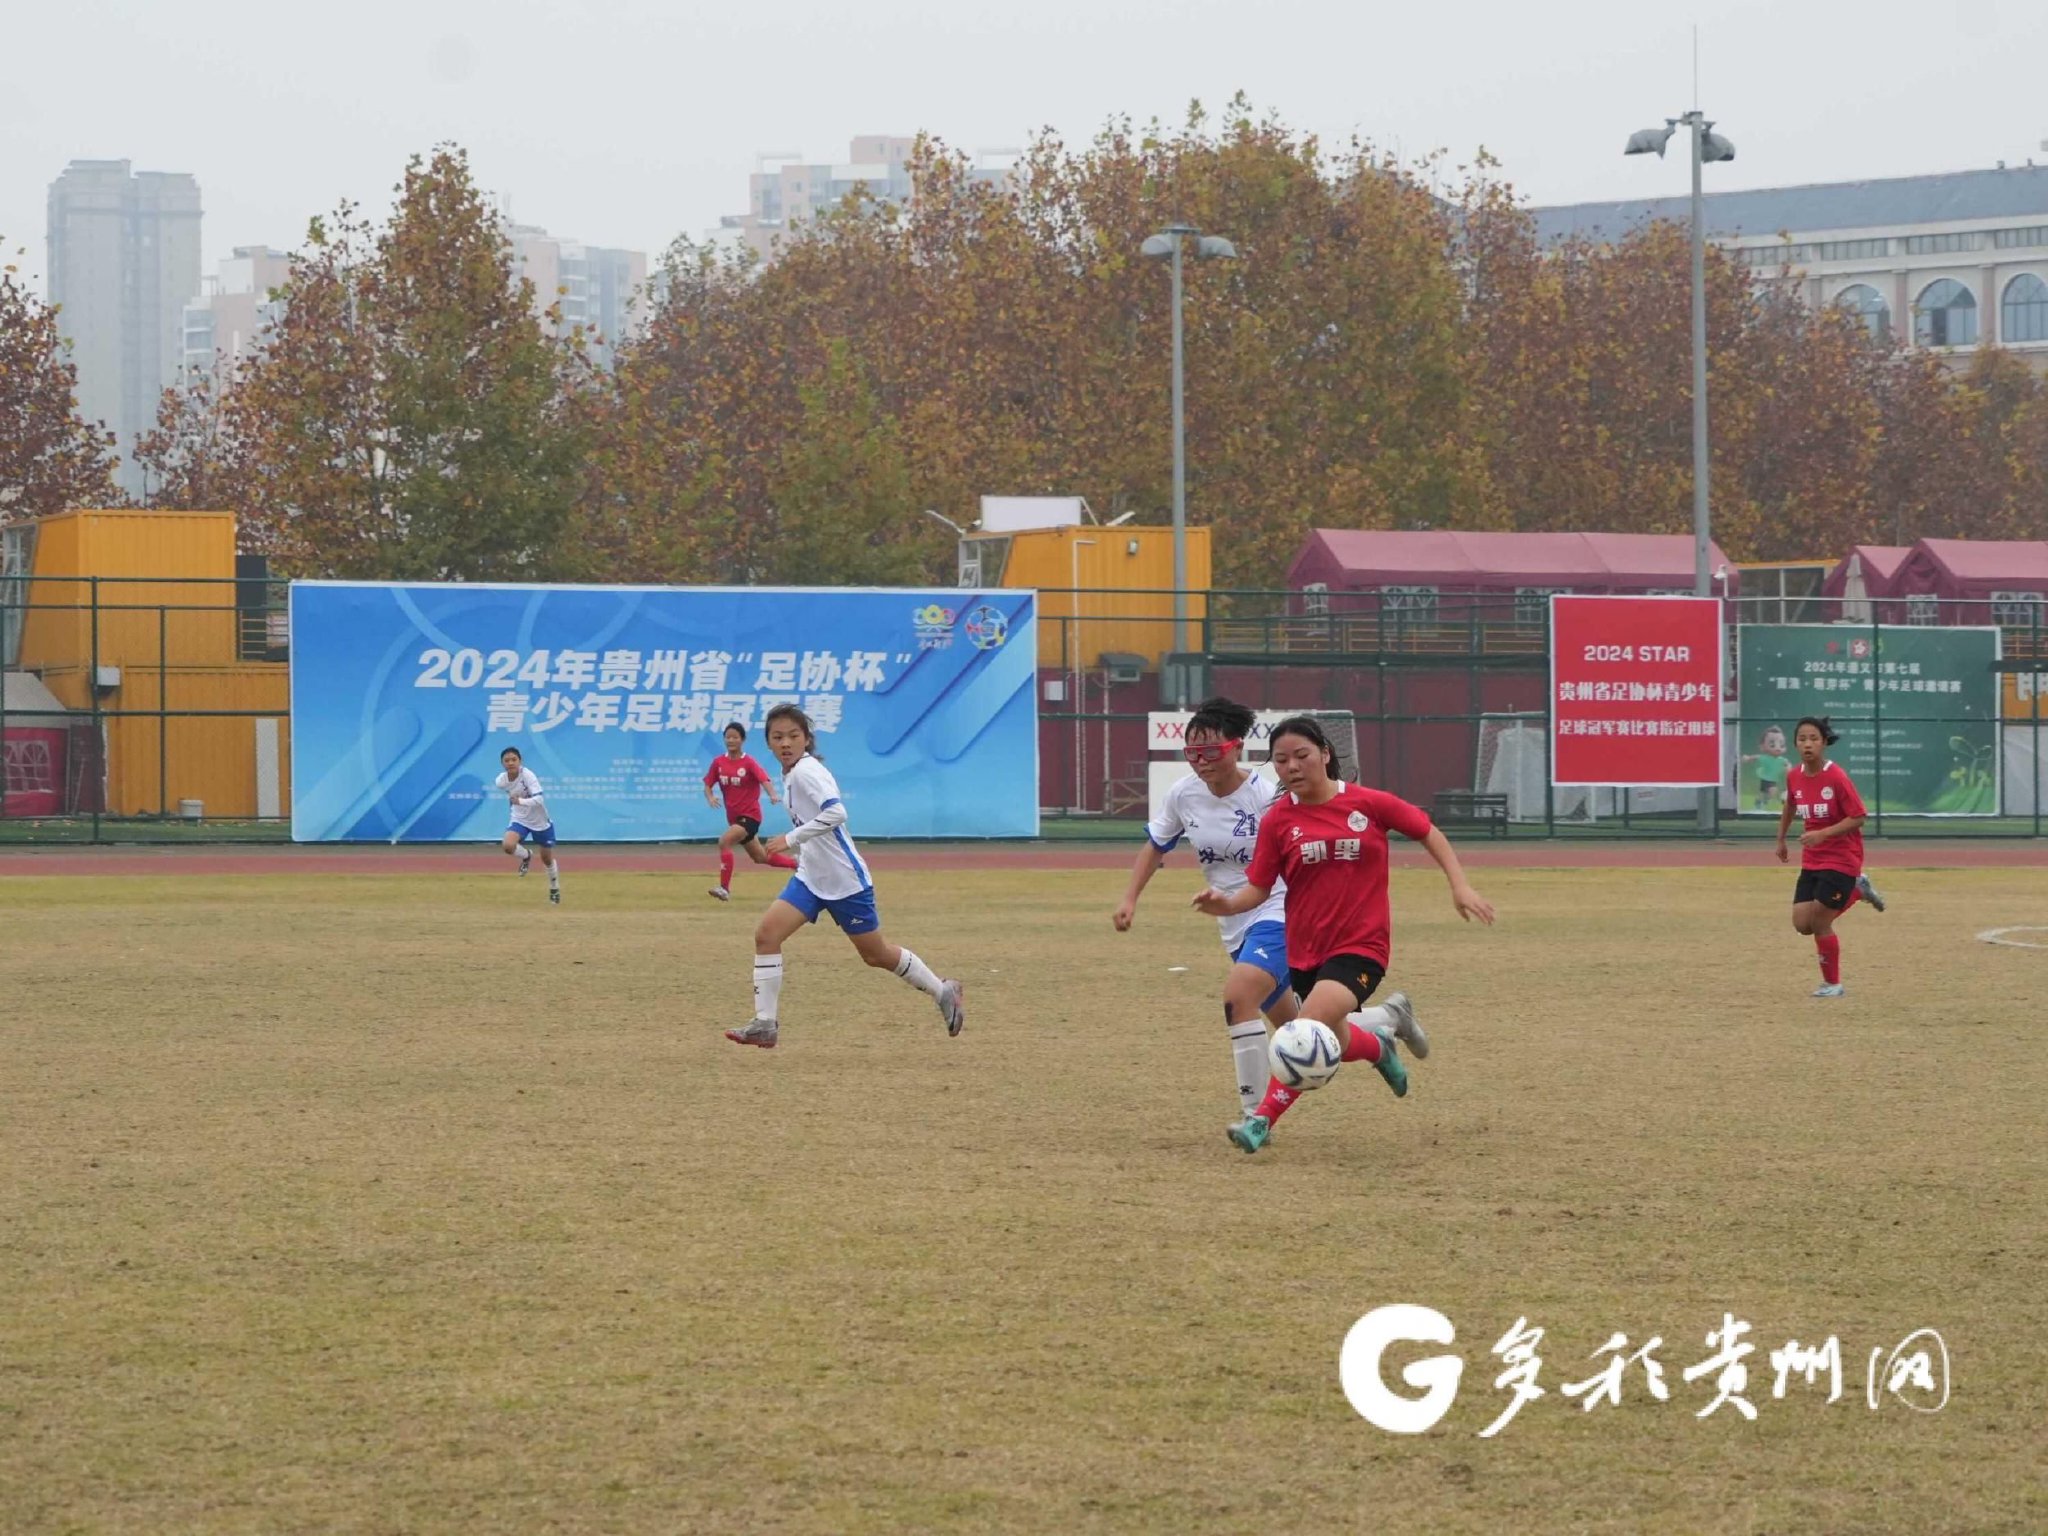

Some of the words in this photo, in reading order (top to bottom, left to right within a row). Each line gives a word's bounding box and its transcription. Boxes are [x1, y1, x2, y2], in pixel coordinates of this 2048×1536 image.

[1584, 645, 1634, 661] 2024
[1639, 646, 1690, 662] STAR
[1559, 681, 1715, 701] 贵州省足协杯青少年
[1558, 719, 1715, 736] 足球冠军赛比赛指定用球
[1232, 809, 1257, 837] 21
[1300, 838, 1361, 865] 凯里
